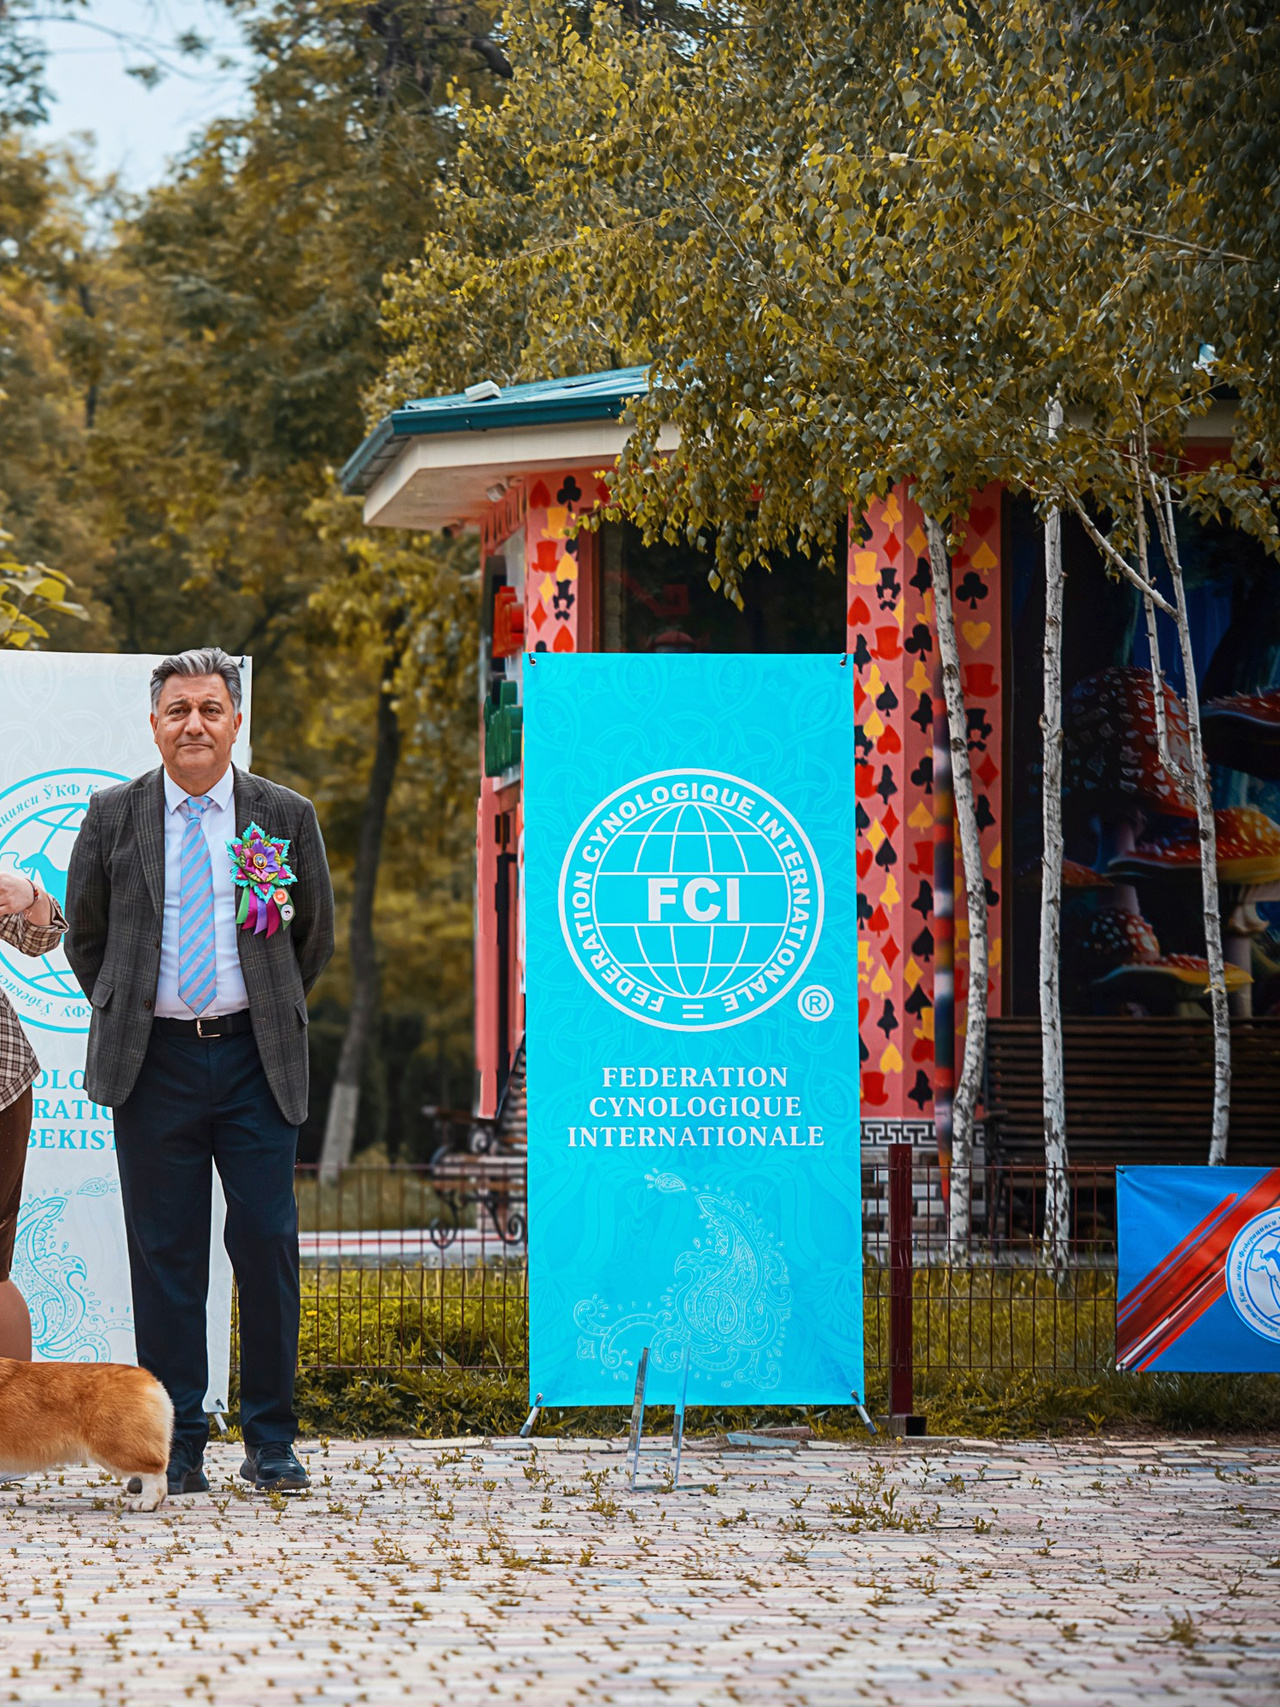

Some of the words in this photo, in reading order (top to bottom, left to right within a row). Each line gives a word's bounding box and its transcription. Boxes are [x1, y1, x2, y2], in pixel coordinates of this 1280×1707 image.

[582, 782, 756, 864] CYNOLOGIQUE
[647, 877, 740, 922] FCI
[721, 811, 811, 1013] INTERNATIONALE
[572, 870, 665, 1013] FEDERATION
[602, 1066, 788, 1088] FEDERATION
[589, 1096, 802, 1119] CYNOLOGIQUE
[567, 1126, 825, 1147] INTERNATIONALE
